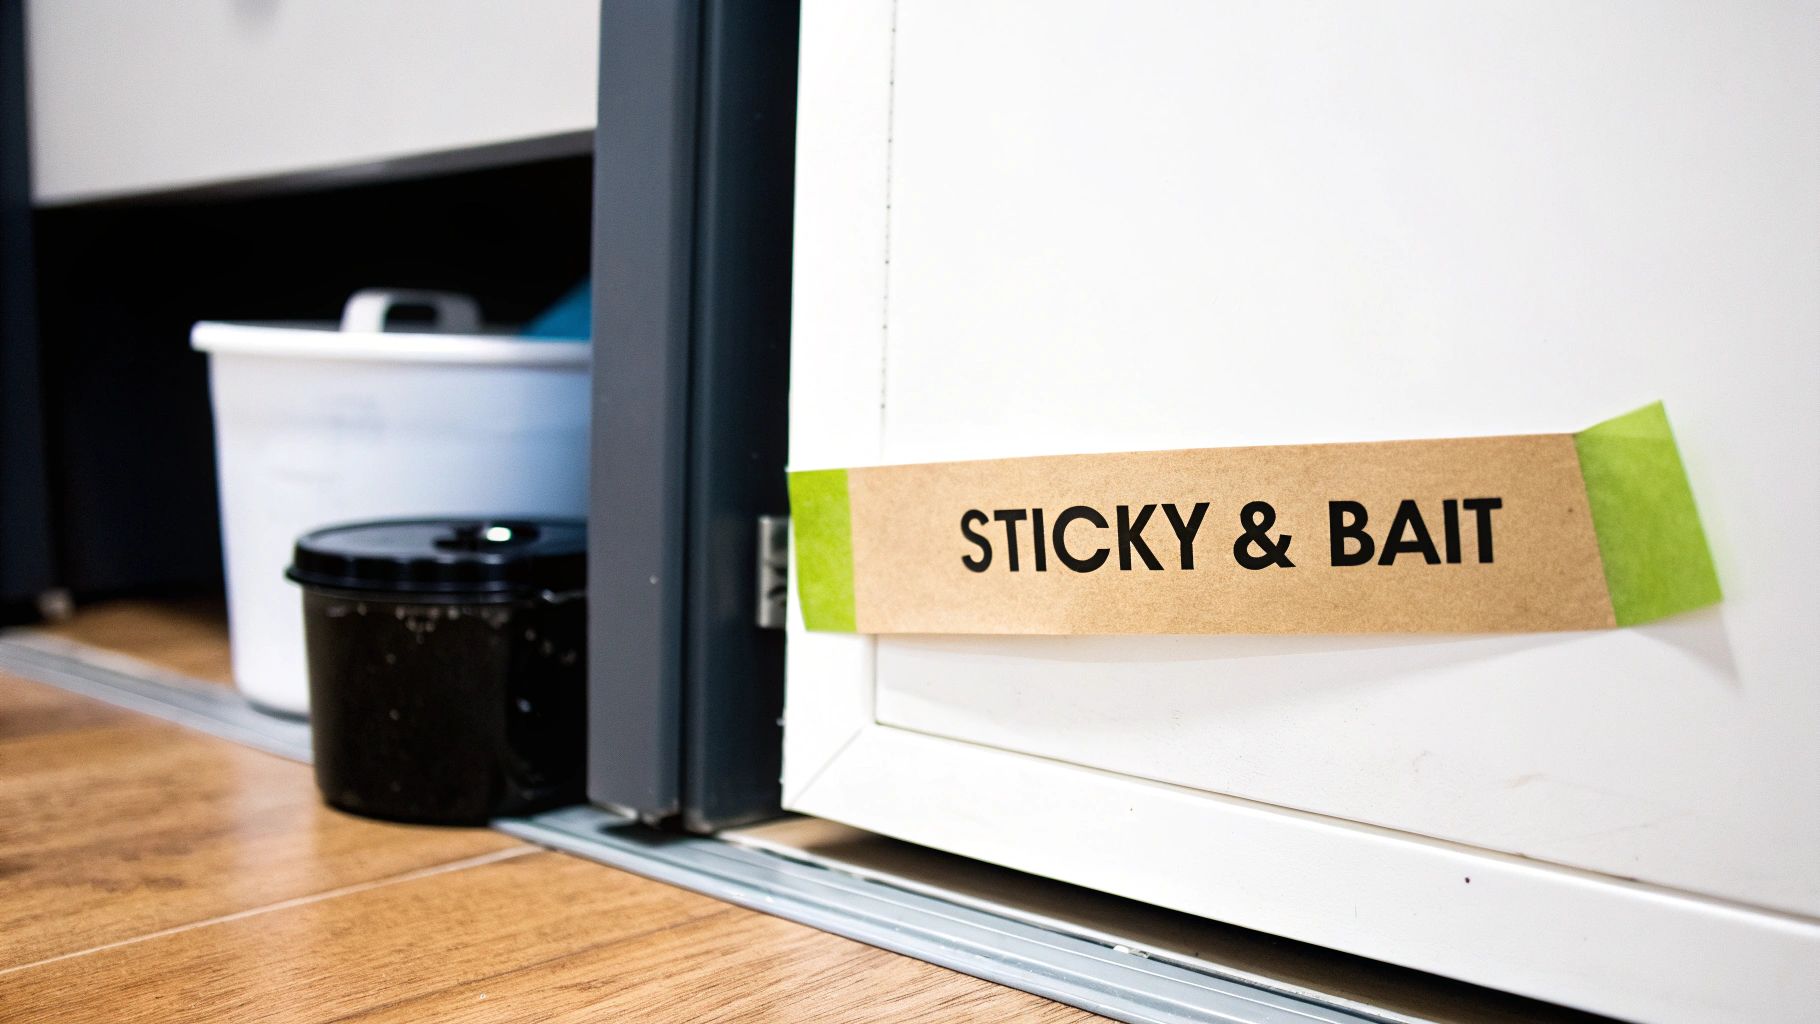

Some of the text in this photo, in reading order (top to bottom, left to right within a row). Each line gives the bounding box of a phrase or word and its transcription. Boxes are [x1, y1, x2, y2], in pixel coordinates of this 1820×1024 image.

[960, 497, 1503, 574] STICKY & BAIT
